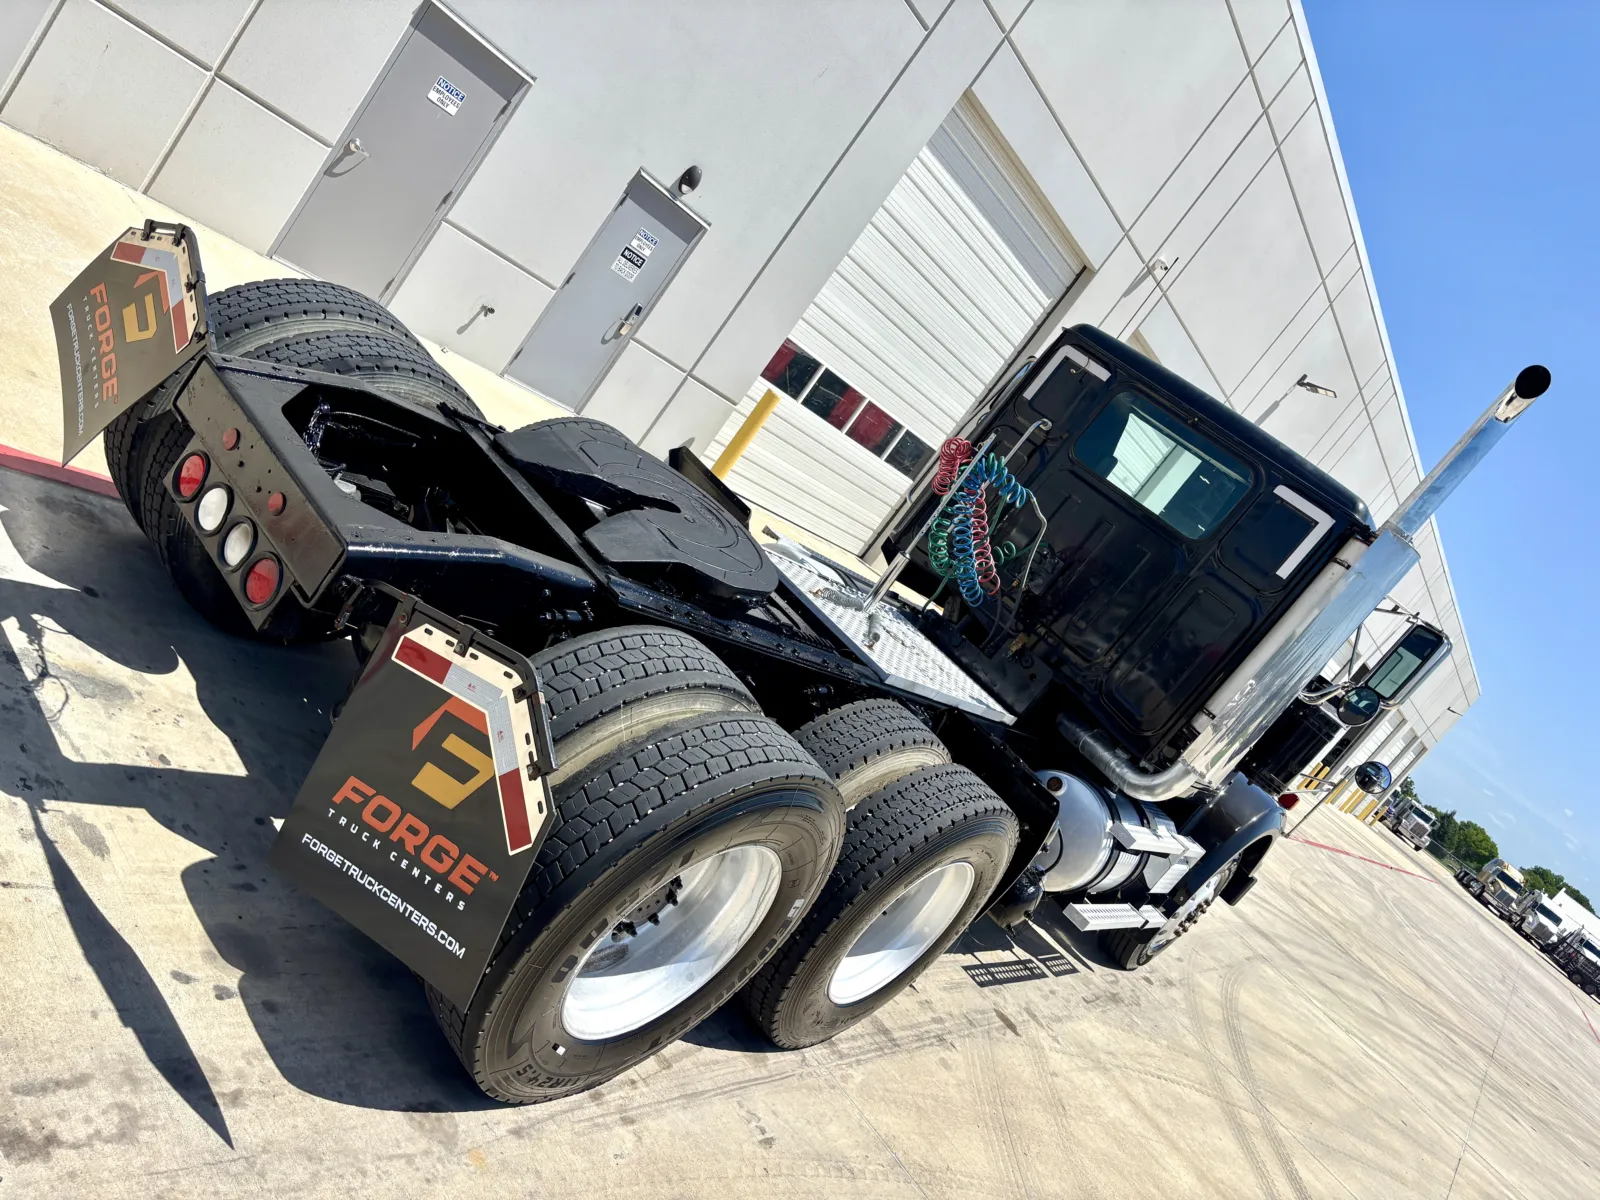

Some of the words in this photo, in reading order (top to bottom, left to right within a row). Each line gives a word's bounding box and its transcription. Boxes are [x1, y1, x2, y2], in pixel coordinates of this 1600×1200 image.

[432, 86, 460, 108] EMPLOYEES
[438, 78, 463, 101] NOTICE
[436, 97, 450, 108] ONLY
[638, 229, 658, 246] NOTICE
[623, 249, 644, 266] NOTICE
[82, 296, 94, 340] TRUCK
[90, 346, 99, 409] CENTERS
[66, 303, 84, 436] FORGETRUCKCENTERS.COM
[327, 808, 381, 850] TRUCK
[389, 851, 466, 911] CENTERS
[301, 832, 467, 959] FORGETRUCKCENTERS.COM
[515, 1063, 581, 1089] 11R24.5
